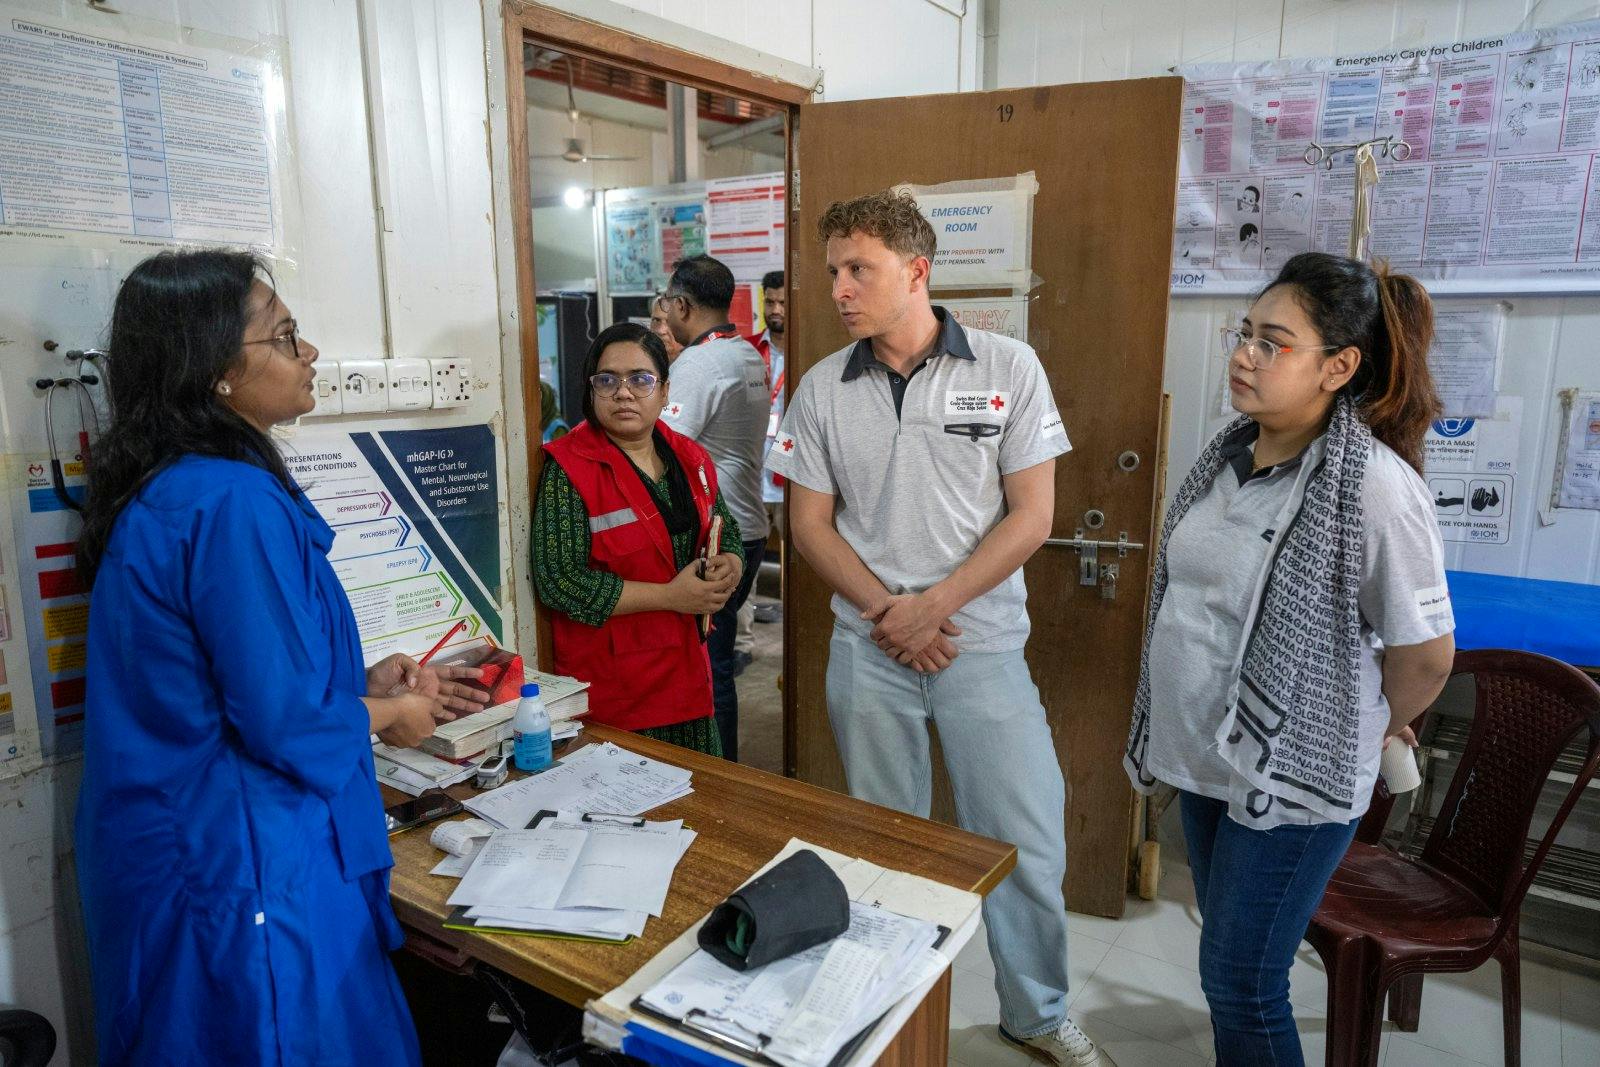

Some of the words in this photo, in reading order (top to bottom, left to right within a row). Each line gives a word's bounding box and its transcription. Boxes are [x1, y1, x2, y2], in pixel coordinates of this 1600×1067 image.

[44, 29, 60, 37] Case
[61, 32, 96, 46] Definition
[96, 40, 107, 48] for
[107, 42, 137, 54] Different
[137, 48, 165, 61] Diseases
[171, 56, 204, 68] Syndromes
[1335, 52, 1397, 67] Emergency
[1400, 48, 1428, 60] Care
[1430, 45, 1448, 57] for
[1451, 37, 1504, 54] Children
[996, 104, 1014, 123] 19
[931, 205, 993, 218] EMERGENCY
[945, 221, 978, 233] ROOM
[934, 249, 950, 257] NTRY
[951, 248, 988, 256] PROHIBITED
[987, 247, 1005, 256] WITH
[934, 258, 948, 267] OUT
[1180, 274, 1205, 285] IOM
[285, 452, 342, 464] PRESENTATIONS
[406, 449, 446, 463] mhGAP-IG
[294, 465, 312, 474] MNS
[313, 461, 358, 472] CONDITIONS
[414, 464, 437, 474] Master
[438, 462, 457, 472] Chart
[457, 460, 468, 470] for
[421, 474, 447, 486] Mental,
[448, 470, 488, 483] Neurological
[429, 488, 443, 497] and
[443, 484, 476, 495] Substance
[477, 482, 489, 491] Use
[436, 497, 468, 508] Disorders
[336, 504, 367, 514] DEPRESSION
[1473, 522, 1498, 530] HANDS
[359, 530, 389, 540] PSYCHOSES
[1480, 530, 1499, 539] IOM
[386, 560, 408, 569] EPILEPSY
